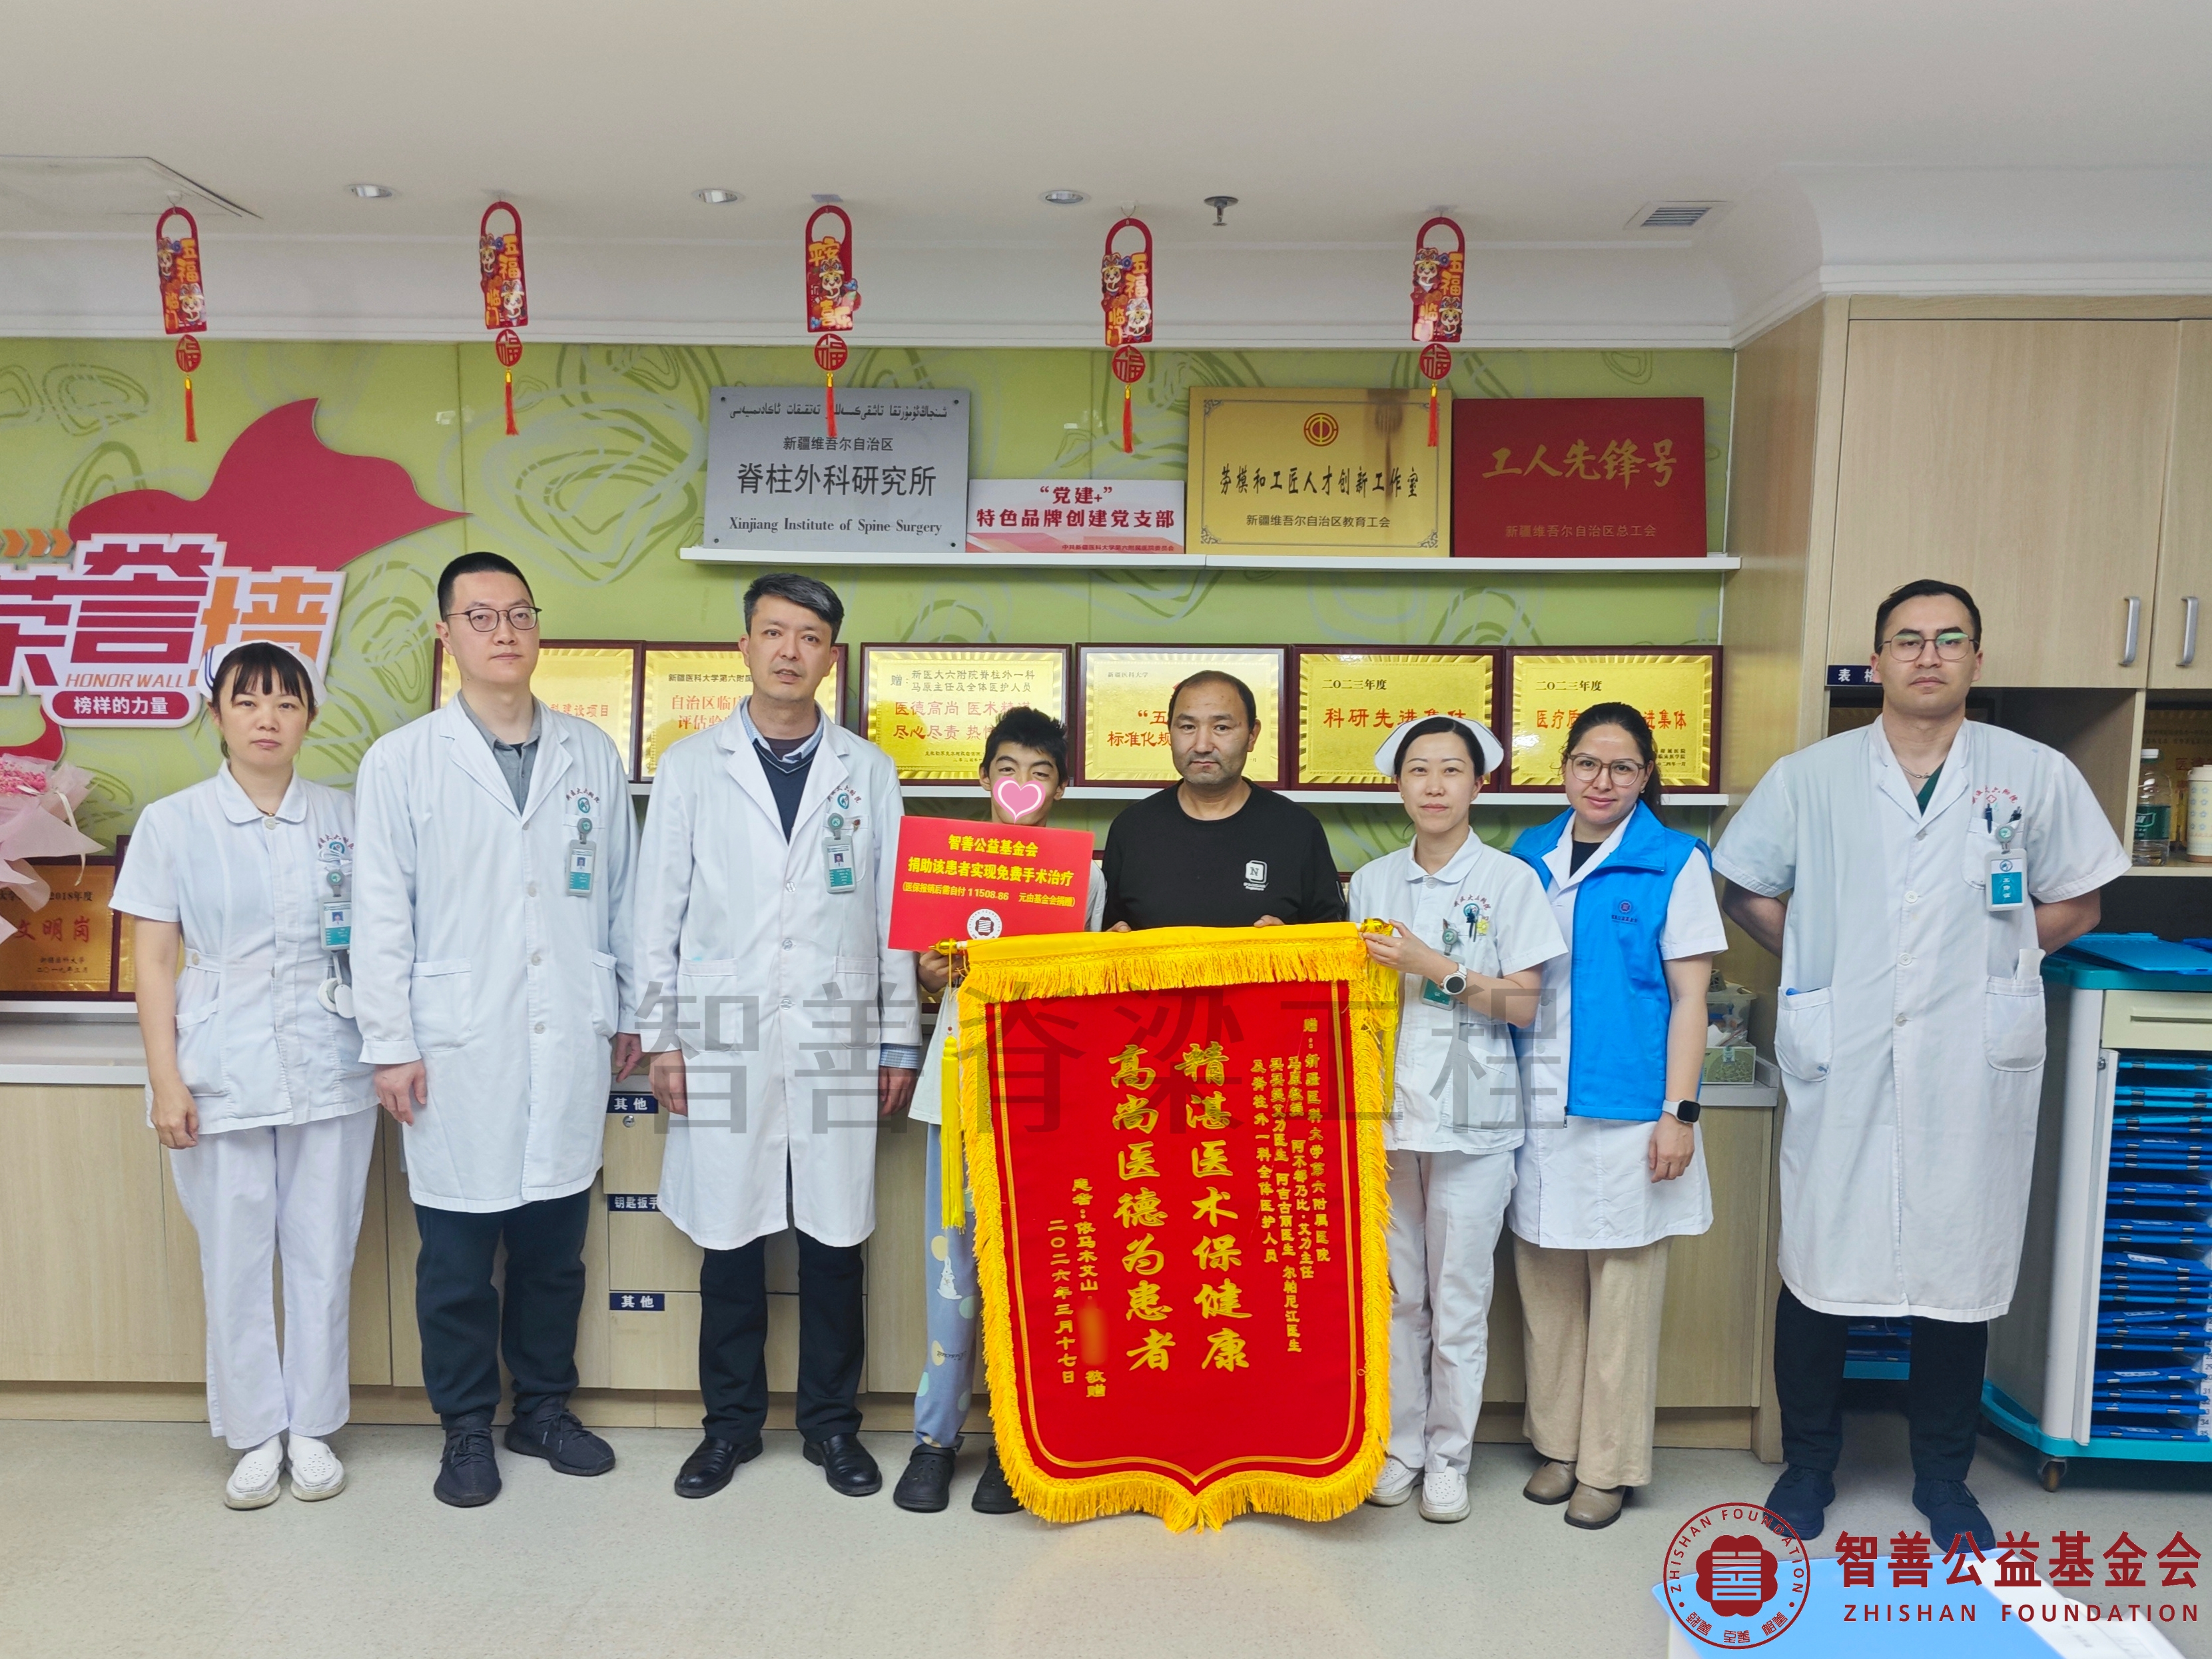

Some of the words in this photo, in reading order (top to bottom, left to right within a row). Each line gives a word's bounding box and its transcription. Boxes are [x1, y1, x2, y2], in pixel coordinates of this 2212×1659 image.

[783, 436, 894, 452] 新疆维吾尔自治区
[1482, 438, 1677, 490] 工人先锋号
[737, 463, 936, 496] 脊柱外科研究所
[1220, 463, 1419, 498] 劳模和工匠人才创新工作室
[729, 517, 778, 533] Xinjiang
[784, 517, 834, 531] Institute
[840, 518, 852, 531] of
[857, 519, 891, 535] Spine
[896, 519, 942, 535] Surgery
[976, 509, 1174, 528] 特色品牌创建党支部
[1246, 514, 1391, 528] 新疆维吾尔自治区教育工会
[1505, 525, 1657, 538] 新疆维吾尔自治区总工会
[65, 673, 133, 688] HONOR
[136, 673, 184, 688] WALL
[911, 669, 1036, 681] 新医大六附院脊柱外一科
[911, 682, 1032, 693] 马原主任及全体医护人员
[73, 696, 169, 715] 榜样的力量
[895, 701, 959, 716] 医德高尚
[678, 715, 730, 730] 评估验
[893, 725, 960, 740] 尽心尽责
[948, 834, 1039, 858] 智善公益基金会
[907, 856, 1074, 886] 捐助该患者实现免费手术治疗
[1249, 866, 1260, 876] N
[613, 1097, 648, 1110] 其他
[1108, 1044, 1176, 1371] 高尚医德为患者
[1174, 1041, 1253, 1372] 精湛医术保健康
[621, 1295, 655, 1308] 其他
